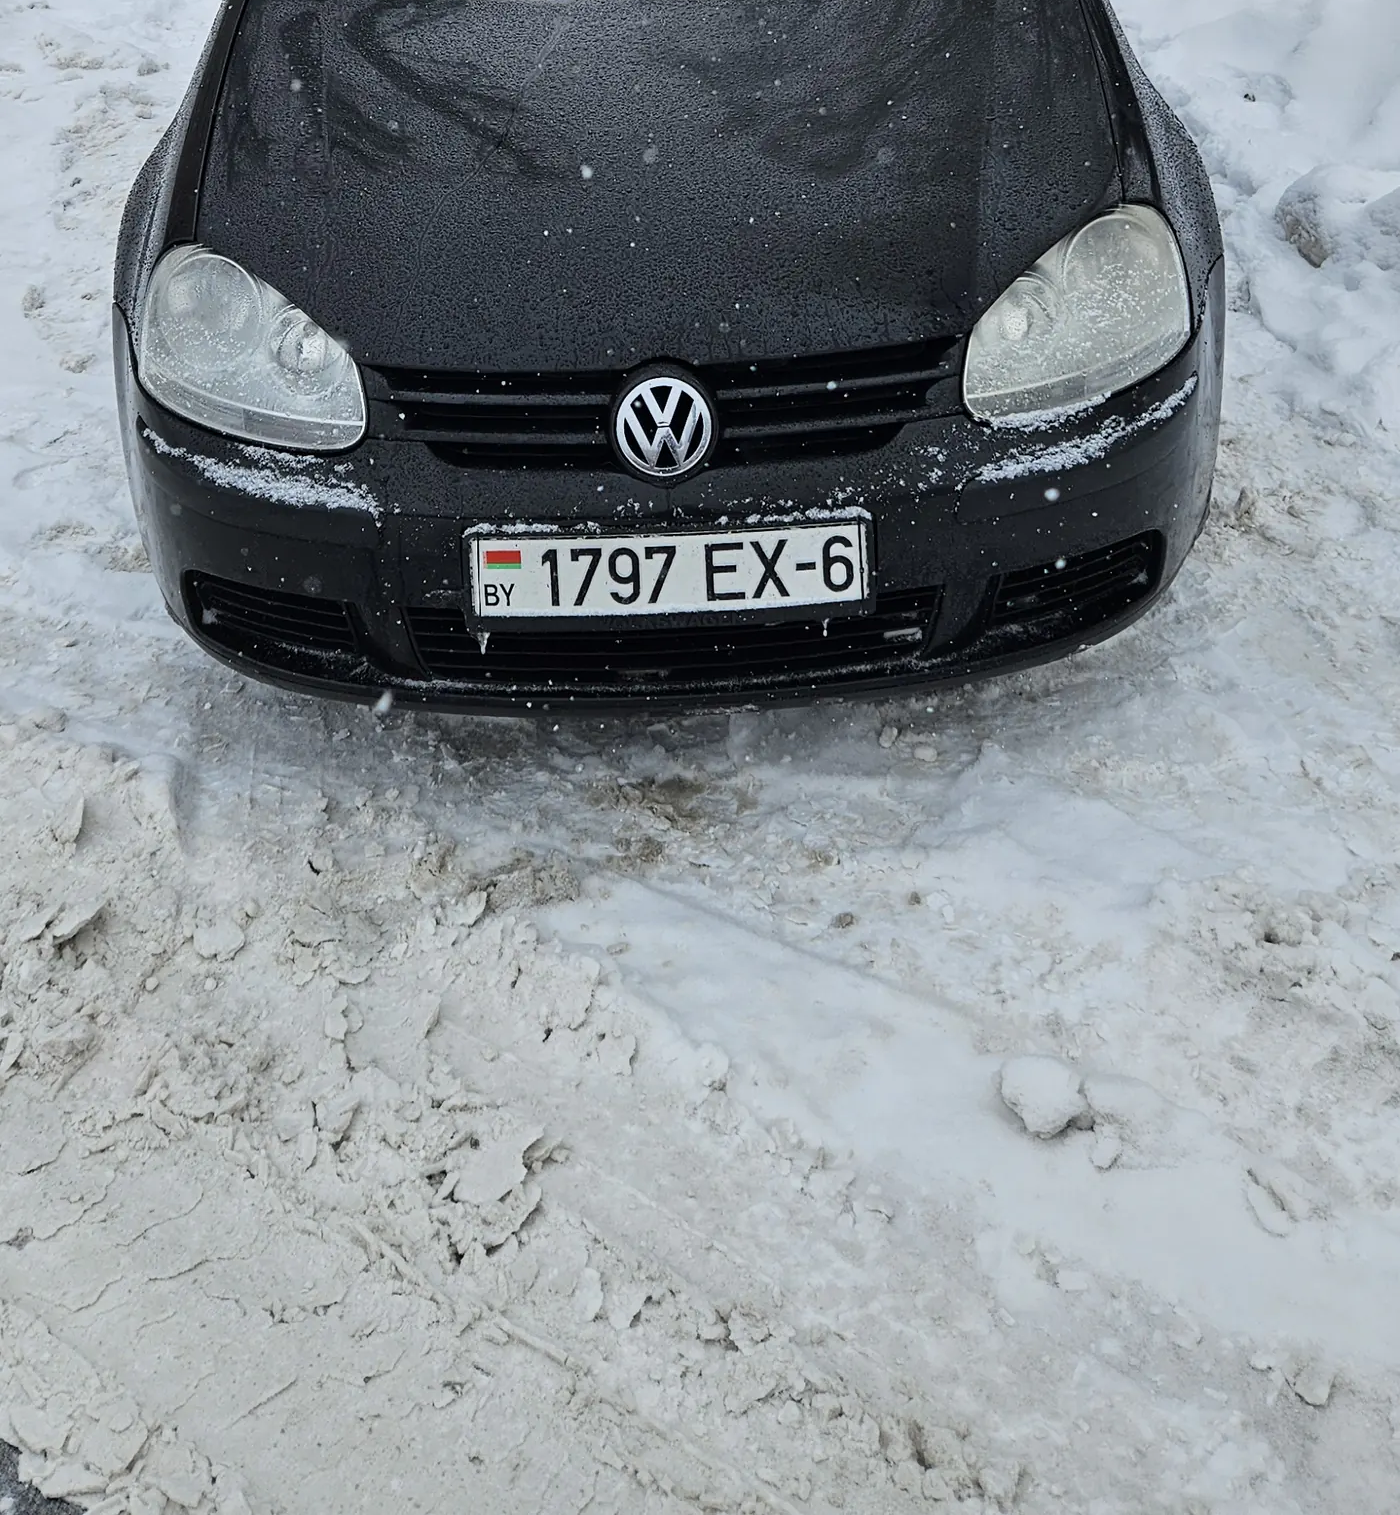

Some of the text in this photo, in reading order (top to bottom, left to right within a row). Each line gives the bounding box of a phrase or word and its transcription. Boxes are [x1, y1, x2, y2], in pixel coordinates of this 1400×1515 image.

[617, 378, 710, 475] VW
[483, 583, 515, 607] BY
[541, 535, 855, 607] 1797 EX-6
